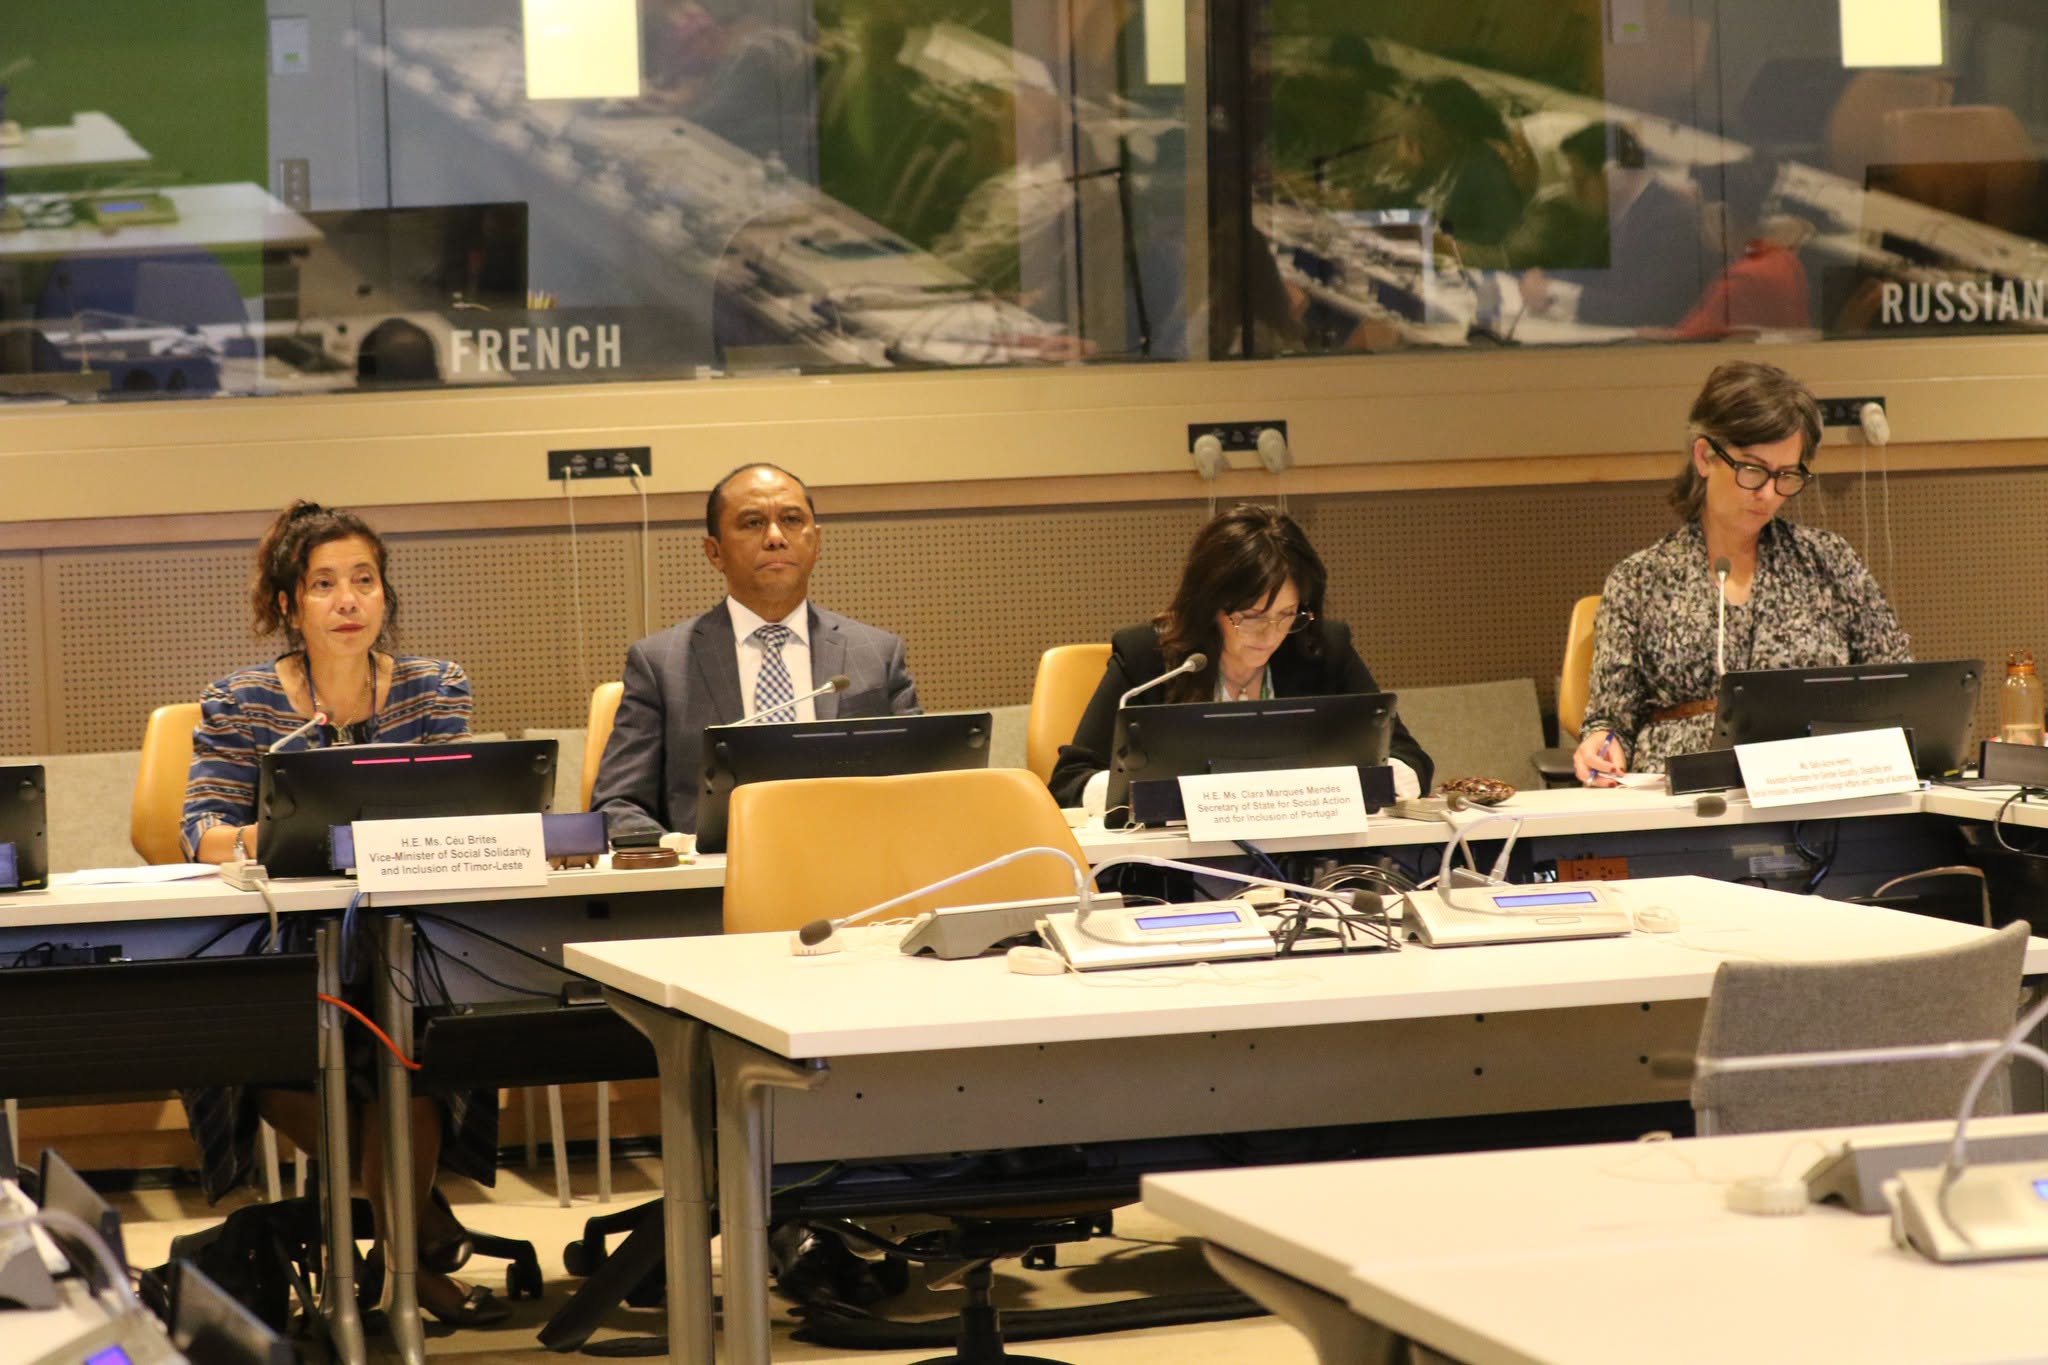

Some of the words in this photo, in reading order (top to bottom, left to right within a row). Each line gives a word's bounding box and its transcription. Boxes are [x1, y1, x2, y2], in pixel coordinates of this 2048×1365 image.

[1882, 279, 2044, 324] RUSSIAN
[451, 324, 621, 373] FRENCH
[1203, 792, 1220, 800] H.E.
[1242, 790, 1264, 799] Clara
[1266, 787, 1304, 798] Marques
[1307, 786, 1341, 795] Mendes
[1198, 804, 1238, 813] Secretary
[1242, 802, 1251, 810] of
[1253, 801, 1275, 810] State
[1277, 799, 1290, 808] for
[1293, 798, 1320, 808] Social
[1322, 796, 1351, 805] Action
[1214, 815, 1230, 824] and
[1233, 814, 1244, 823] for
[1247, 812, 1287, 822] Inclusion
[1290, 811, 1298, 819] of
[1302, 809, 1339, 819] Portugal
[401, 838, 421, 847] H.E.
[425, 837, 441, 847] Ms.
[468, 835, 497, 845] Brites
[369, 851, 435, 863] Vice-Minister
[438, 850, 448, 859] of
[450, 848, 480, 859] Social
[484, 847, 531, 858] Solidarity
[381, 866, 399, 876] and
[403, 864, 447, 874] Inclusion
[451, 862, 461, 873] of
[464, 861, 523, 872] Timor-Leste
